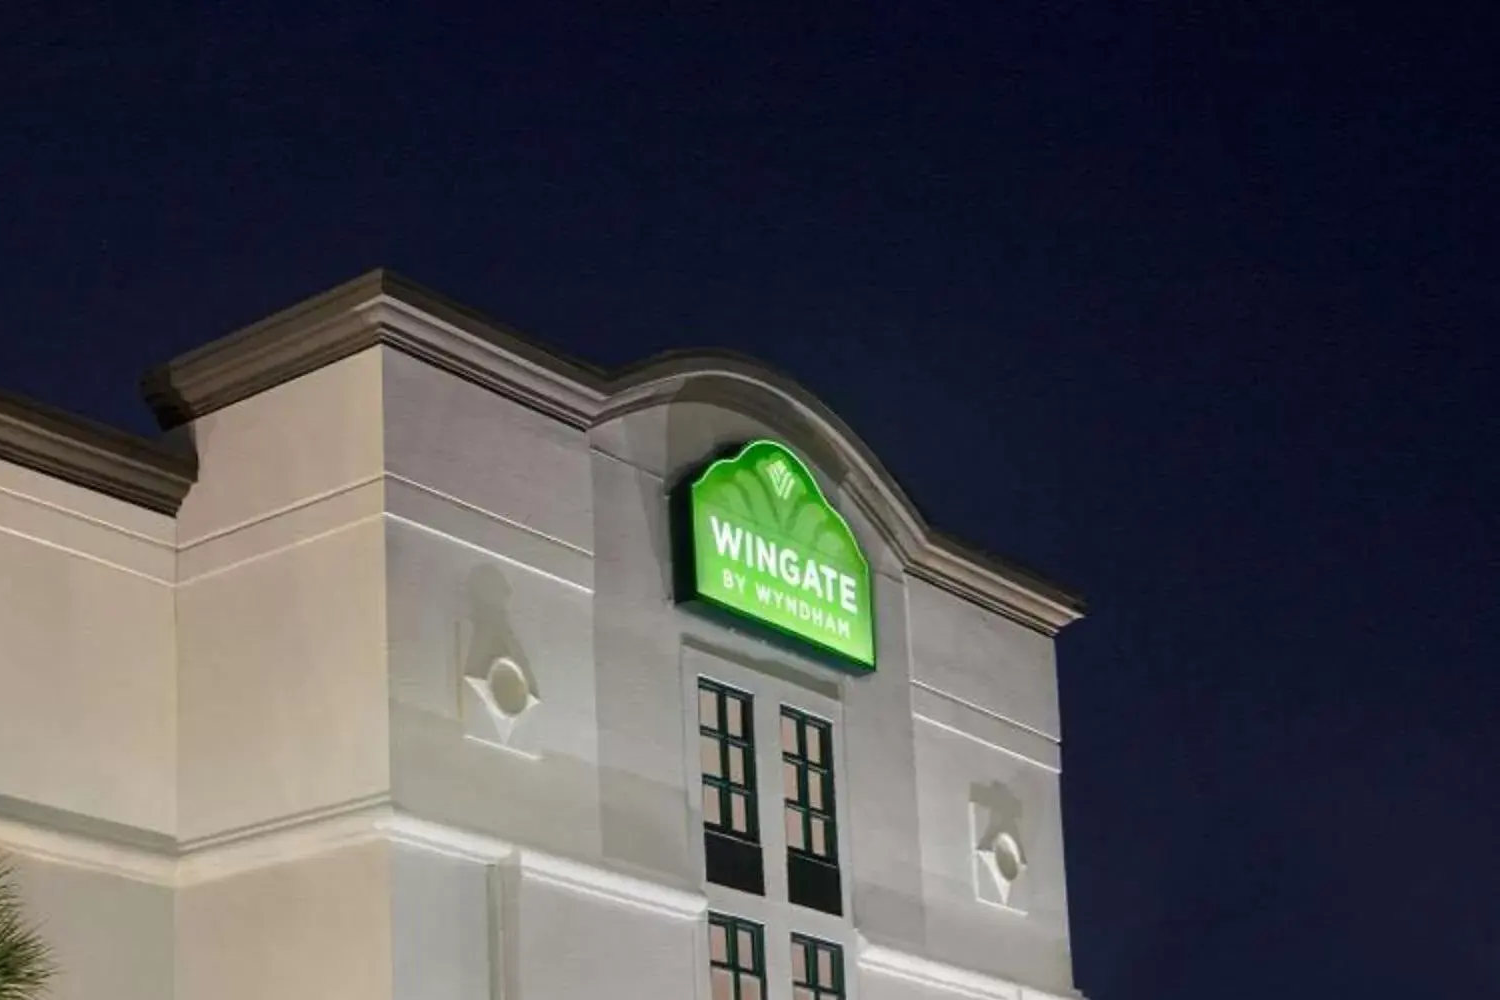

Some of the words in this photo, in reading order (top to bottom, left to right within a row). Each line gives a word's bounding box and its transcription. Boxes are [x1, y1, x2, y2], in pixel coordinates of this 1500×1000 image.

[710, 515, 858, 615] WINGATE
[722, 568, 747, 593] BY
[755, 583, 850, 639] WYNDHAM
